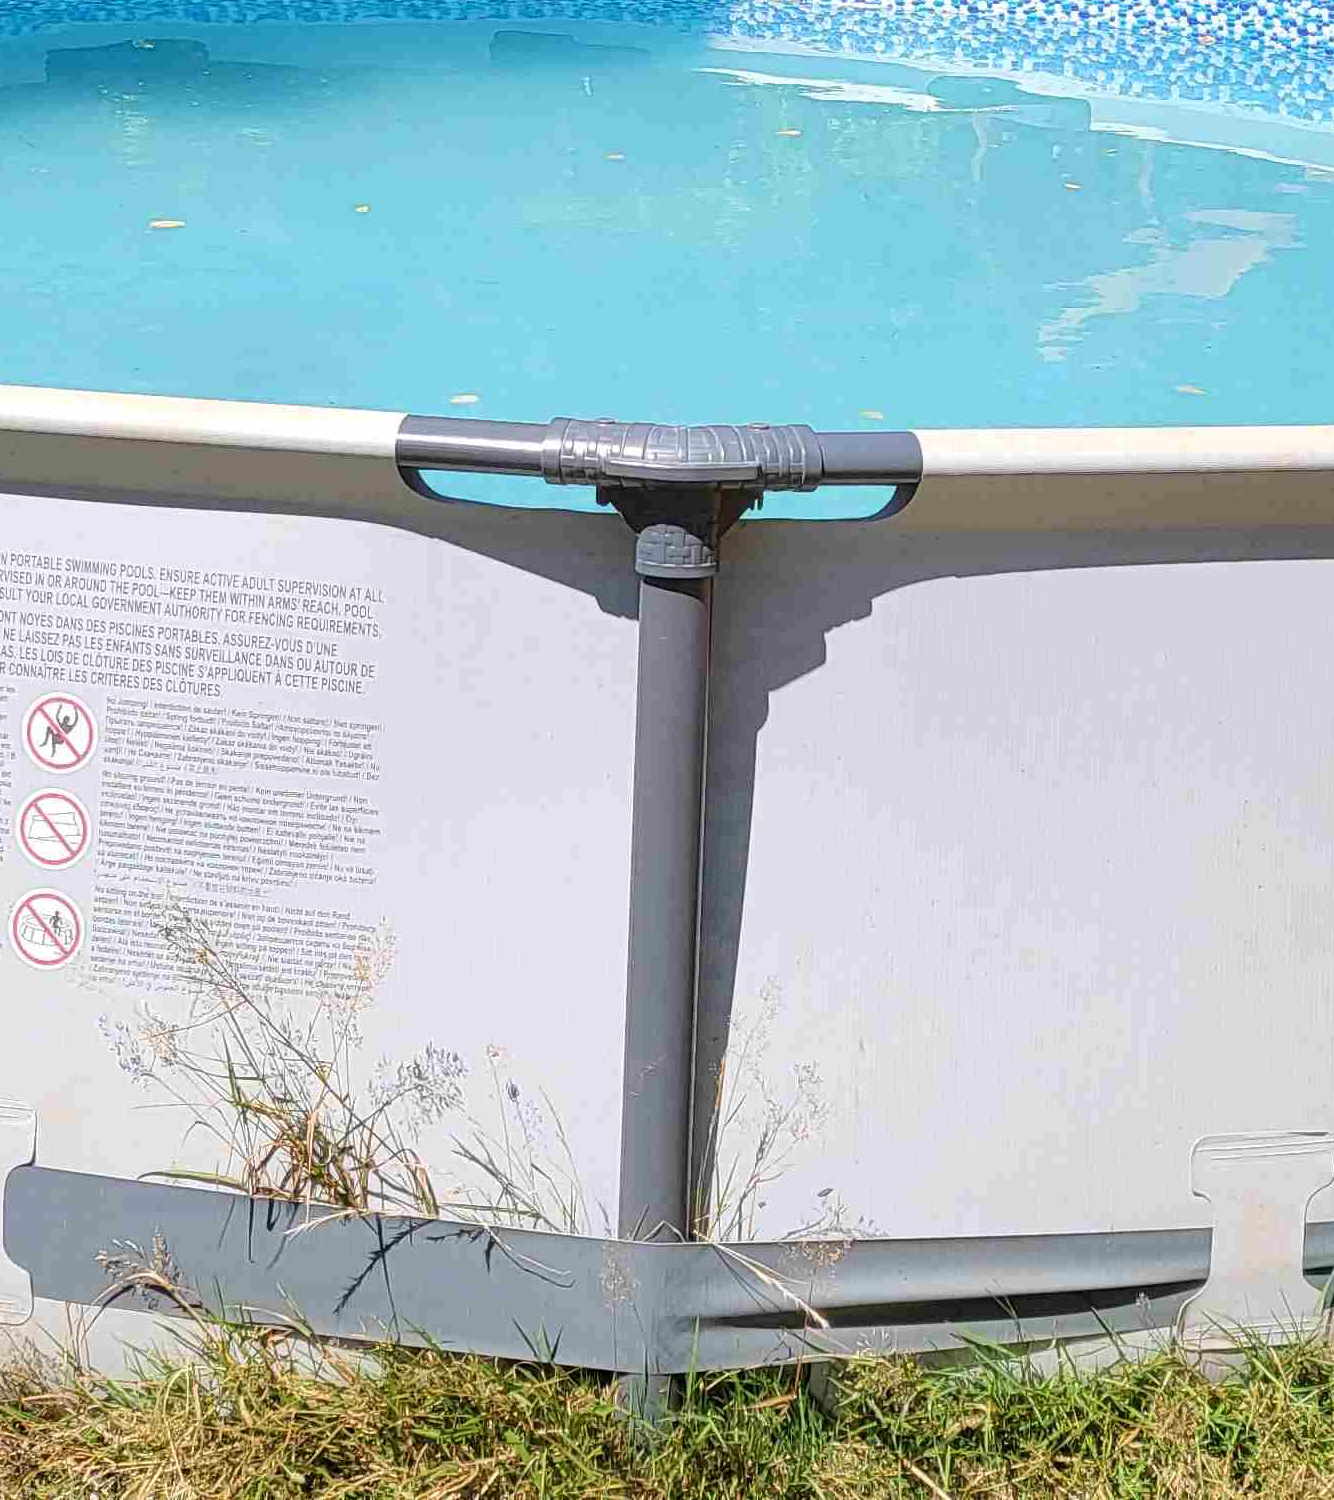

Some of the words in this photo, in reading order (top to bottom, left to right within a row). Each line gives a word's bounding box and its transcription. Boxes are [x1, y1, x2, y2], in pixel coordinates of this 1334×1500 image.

[10, 552, 62, 570] PORTABLE
[64, 558, 117, 576] SWIMMING
[159, 567, 199, 584] ENSURE
[202, 572, 240, 588] ACTIVE
[242, 576, 275, 592] ADULT
[277, 579, 347, 599] SUPERVISION
[349, 586, 364, 601] AT
[366, 588, 384, 603] ALL
[35, 572, 45, 586] IN
[47, 573, 62, 587] OR
[64, 575, 107, 592] AROUND
[110, 579, 129, 594] THE
[200, 588, 226, 604] THEM
[229, 591, 265, 608] WITHIN
[25, 588, 53, 604] YOUR
[56, 591, 88, 608] LOCAL
[91, 595, 161, 615] GOVERNMENT
[163, 602, 221, 621] AUTHORITY
[225, 609, 245, 624] FOR
[248, 611, 293, 629] FENCING
[3, 626, 16, 640] NE
[19, 628, 59, 645] LAISSEZ
[62, 632, 82, 647] PAS
[84, 635, 103, 650] LES
[106, 637, 151, 655] ENFANTS
[154, 642, 181, 658] SANS
[185, 645, 262, 666] SURVEILLANCE
[265, 653, 293, 669] DANS
[296, 657, 311, 671] OU
[315, 658, 358, 676] AUTOUR
[361, 663, 376, 678] DE
[56, 615, 83, 631] DANS
[86, 618, 106, 633] DES
[109, 620, 155, 638] PISCINES
[223, 632, 303, 653] ASSUREZ-VOUS
[306, 641, 338, 657] D'UNE
[19, 644, 37, 659] LES
[40, 647, 63, 662] LOIS
[66, 650, 80, 664] DE
[132, 657, 153, 672] DES
[155, 659, 194, 677] PISCINE
[285, 673, 318, 690] CETTE
[69, 668, 87, 683] LES
[143, 676, 163, 691] DES
